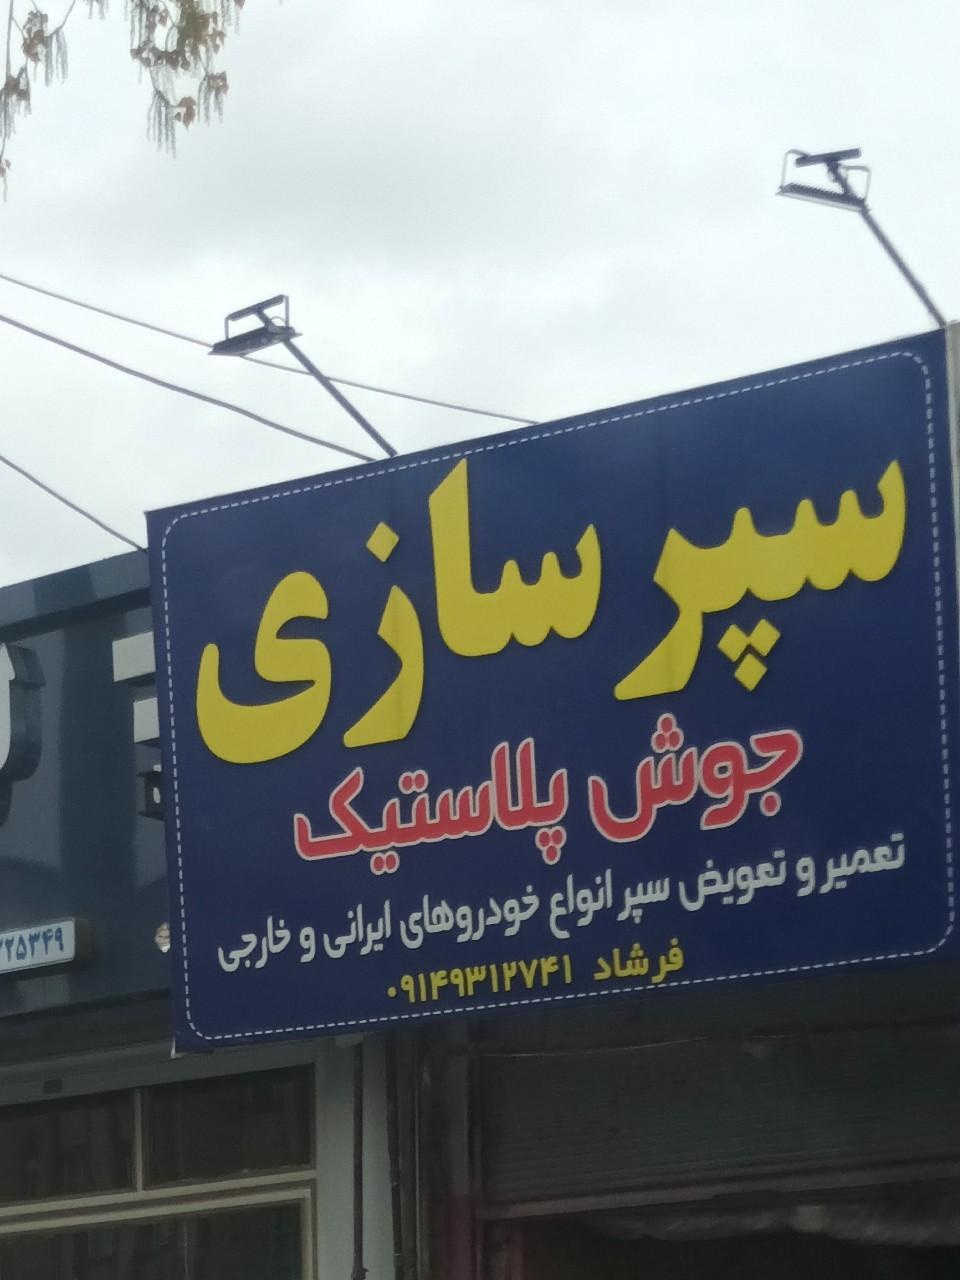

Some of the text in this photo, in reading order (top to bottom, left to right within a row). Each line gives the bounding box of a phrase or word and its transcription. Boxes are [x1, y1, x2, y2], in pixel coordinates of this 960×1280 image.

[293, 712, 804, 876] جوش پلاستیک
[218, 832, 905, 972] تعمیر و تعویض سپر انواع خودروهای ایرانی و خارجی
[387, 939, 684, 1003] فرشاد ۰۹۱۴۹۳۱۲۷۴۱
